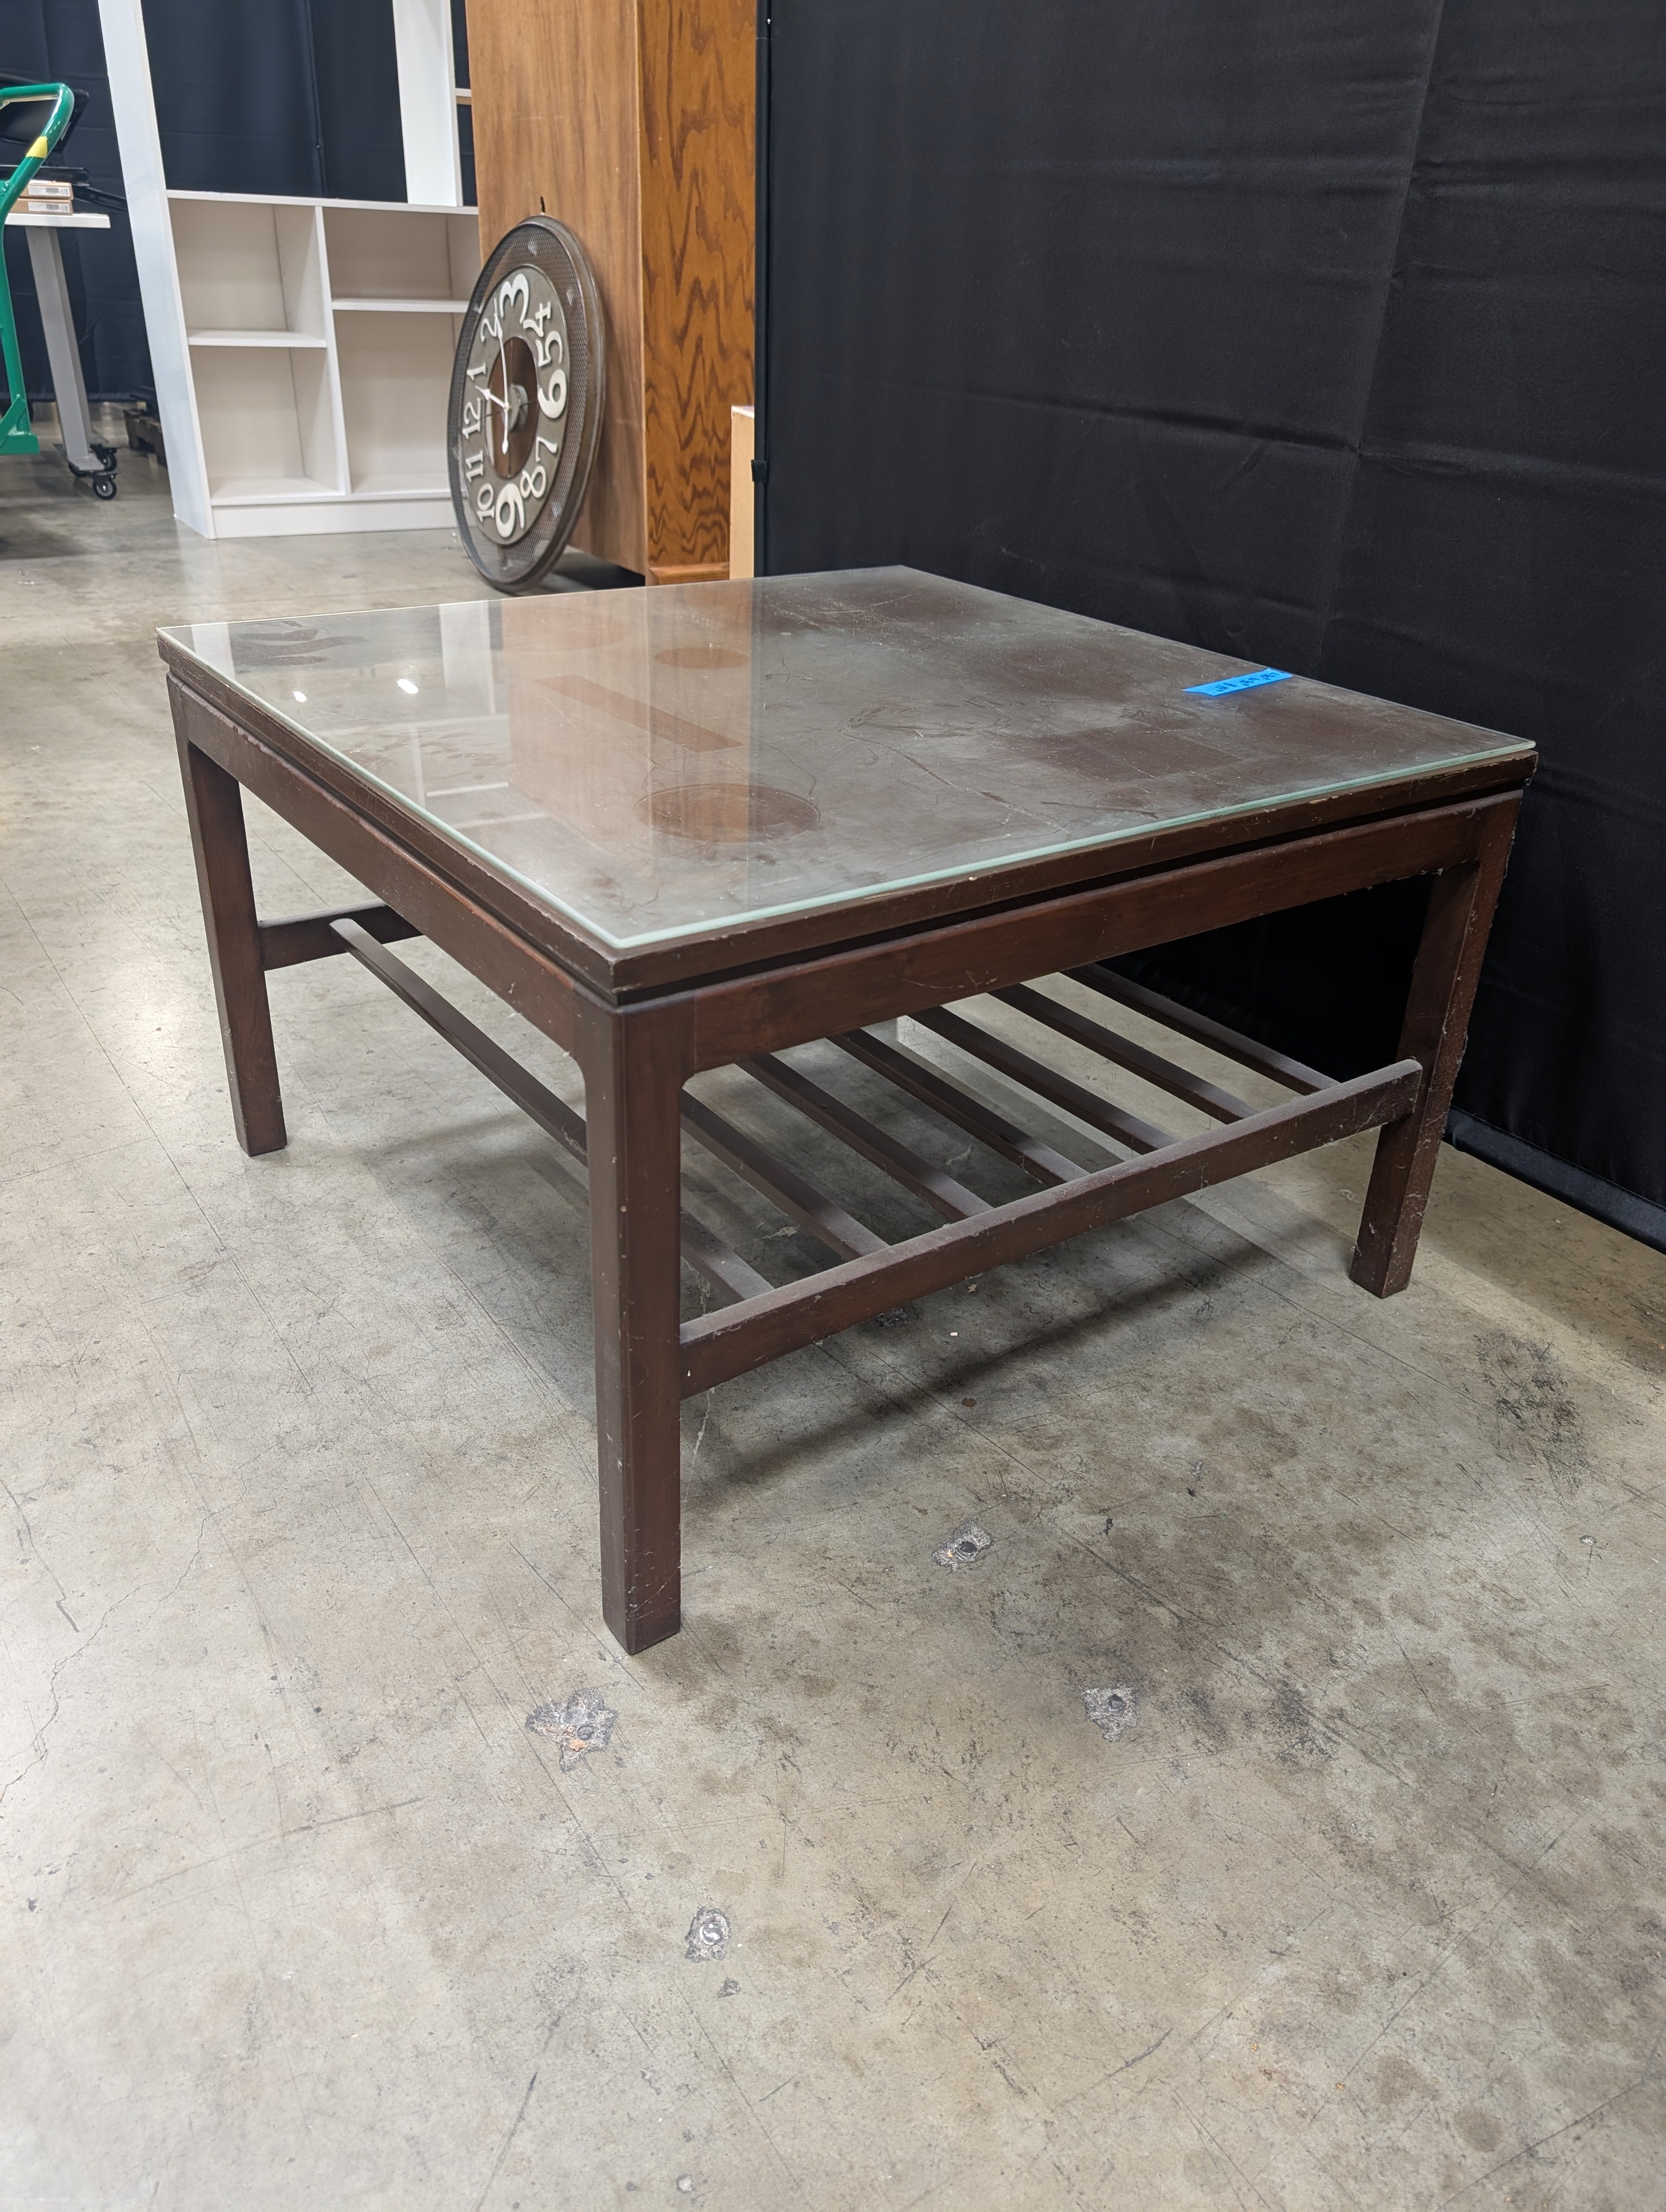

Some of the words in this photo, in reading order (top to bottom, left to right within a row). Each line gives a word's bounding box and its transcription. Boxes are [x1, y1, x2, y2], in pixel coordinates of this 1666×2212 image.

[499, 274, 529, 324] 3
[480, 313, 498, 343] 2
[523, 302, 551, 337] 4
[536, 331, 562, 367] 5
[467, 363, 486, 381] 1
[537, 369, 567, 419] 6
[462, 397, 481, 439] 12
[465, 450, 484, 483] 11
[536, 436, 558, 462] 7
[520, 466, 547, 498] 8
[477, 484, 495, 522] 10
[496, 484, 524, 538] 9
